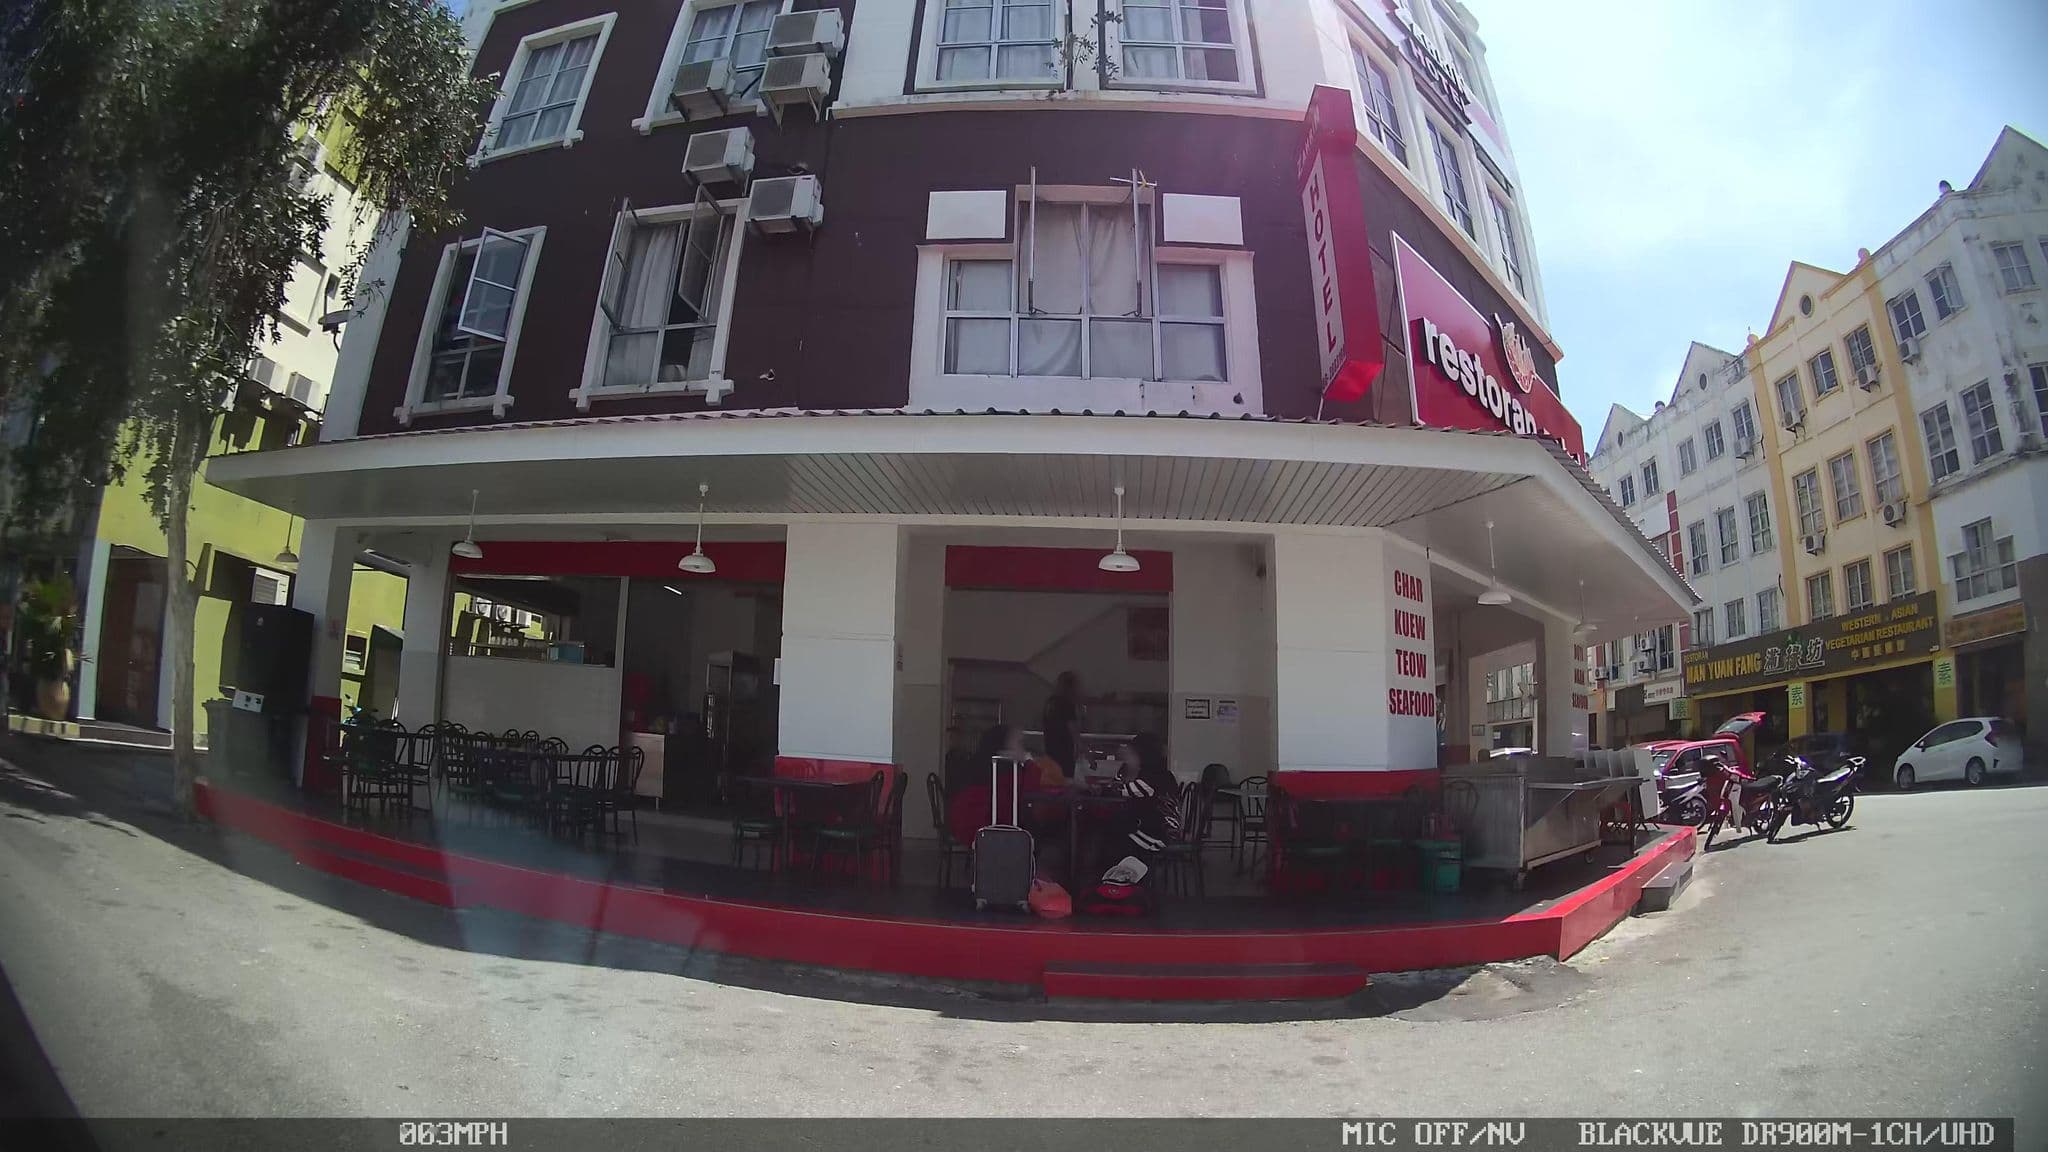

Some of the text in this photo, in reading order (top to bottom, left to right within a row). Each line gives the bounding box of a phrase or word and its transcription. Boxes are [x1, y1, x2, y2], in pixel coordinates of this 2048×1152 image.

[1407, 37, 1471, 123] HOTEL
[1309, 173, 1338, 354] HOTEL
[1421, 317, 1538, 435] restoran
[1394, 569, 1424, 603] CHAR
[1394, 608, 1426, 641] KUEW
[1824, 630, 1876, 651] VEGETARIAN
[1876, 615, 1935, 640] RESTAURANT
[1841, 602, 1919, 632] WESTERN ASIAN
[1395, 648, 1427, 679] TEOW
[1708, 657, 1734, 680] YUAN
[1735, 652, 1762, 676] FANG
[1388, 687, 1436, 718] SEAFOOD
